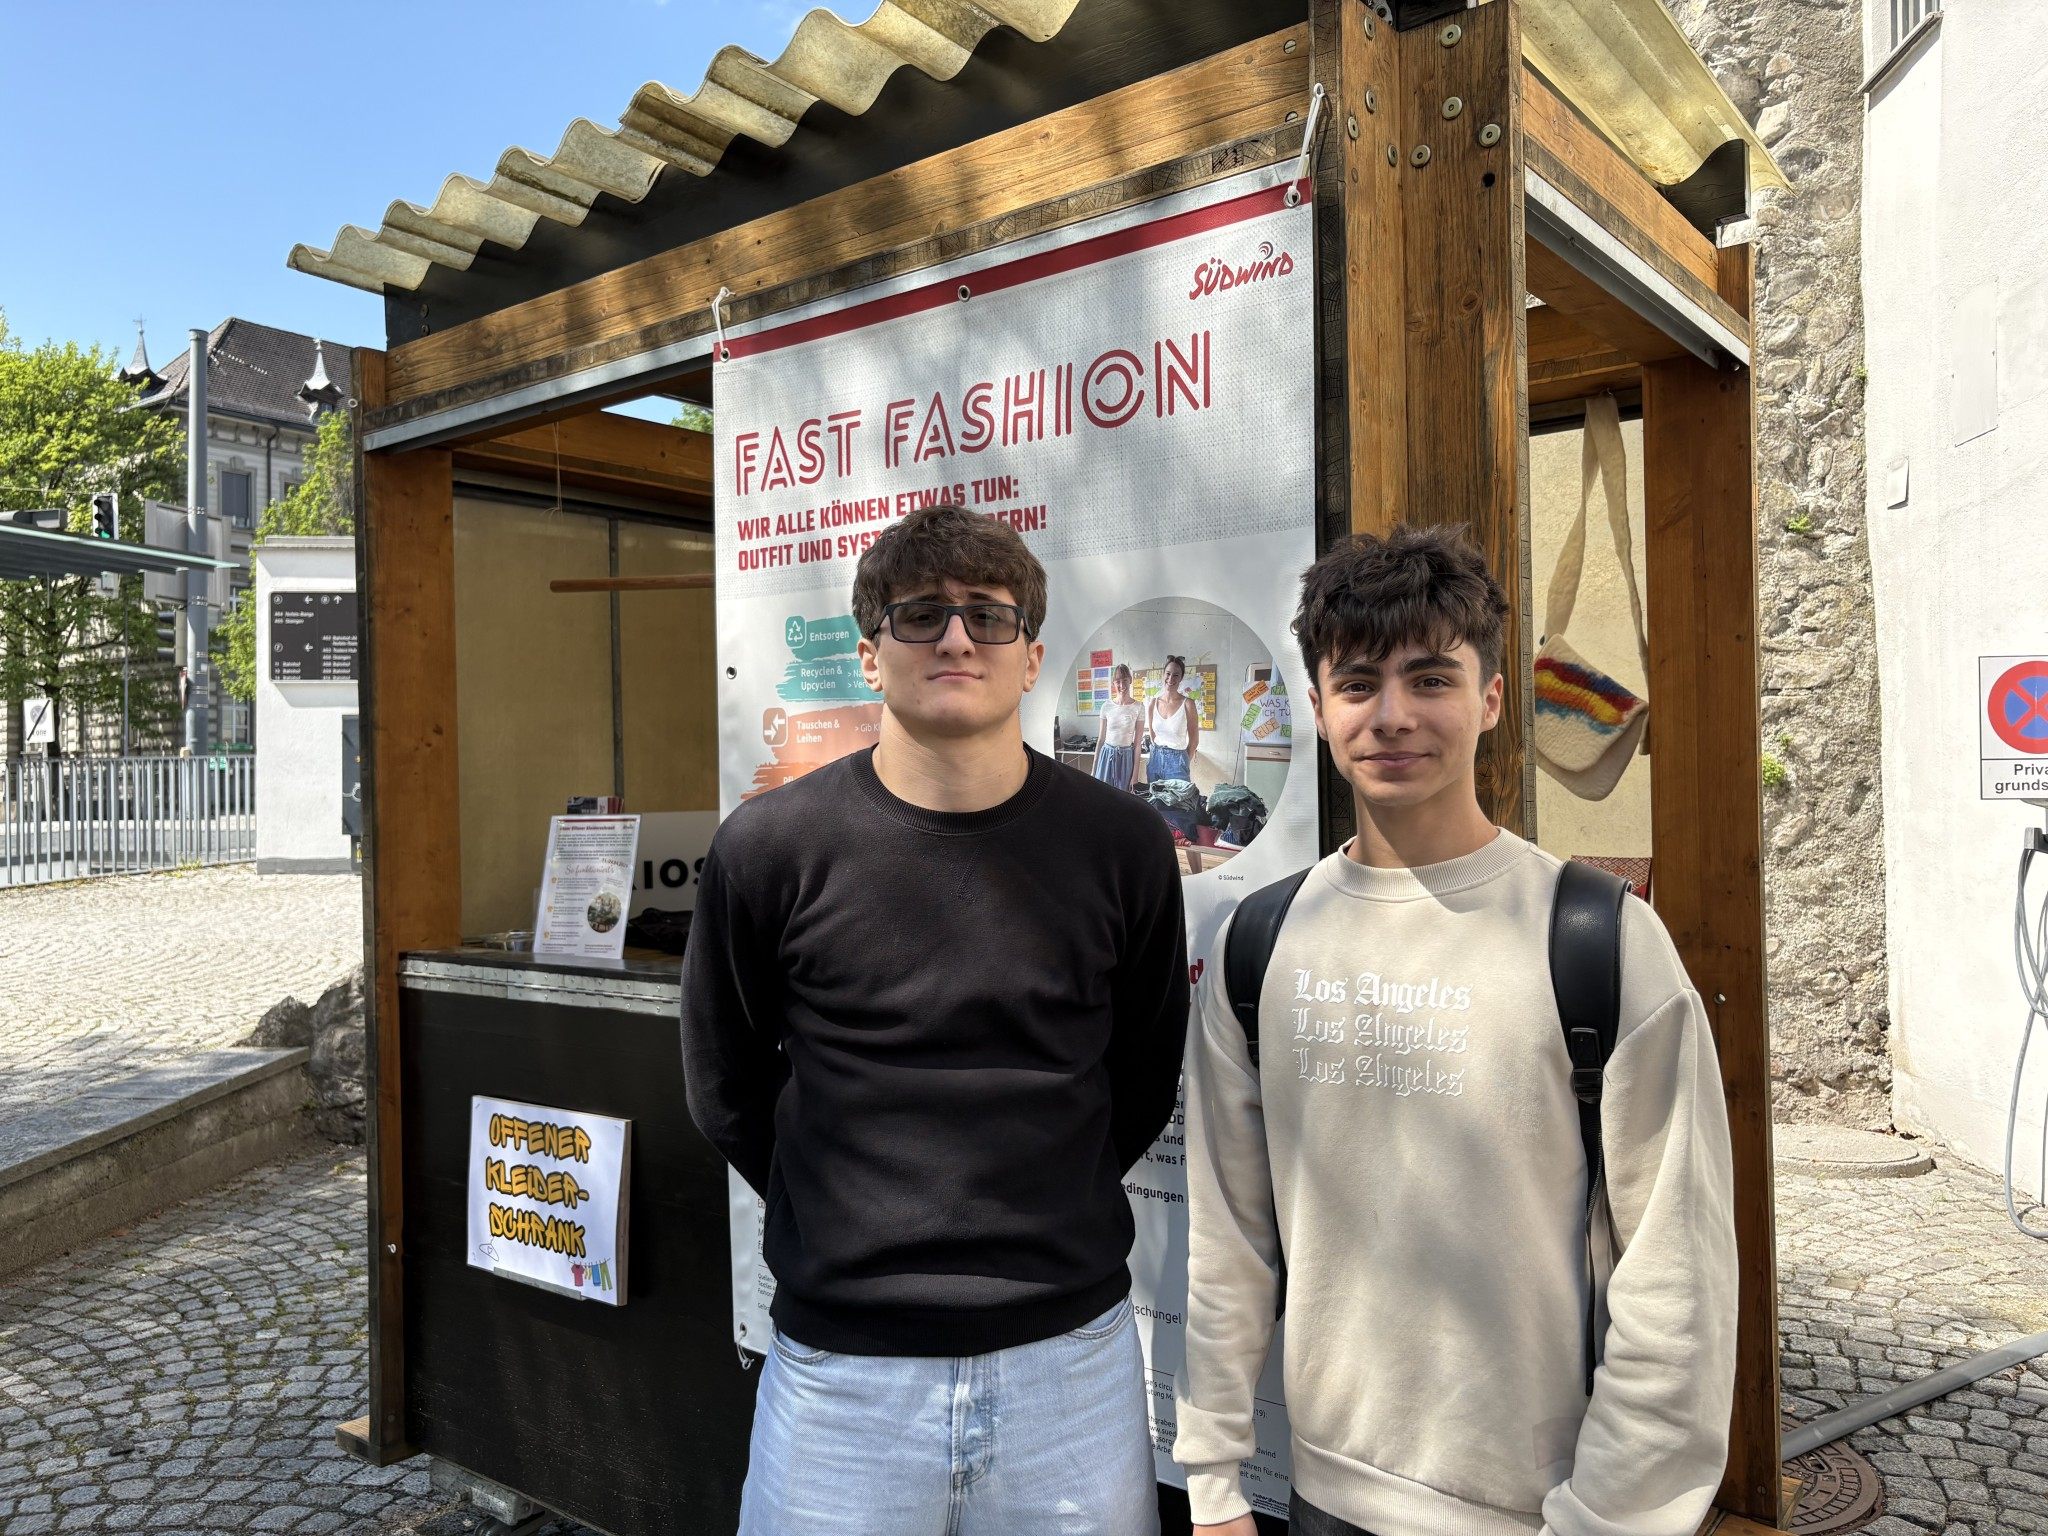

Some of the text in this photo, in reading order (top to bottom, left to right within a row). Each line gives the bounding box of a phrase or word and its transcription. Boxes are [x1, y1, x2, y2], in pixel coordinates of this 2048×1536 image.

[1189, 251, 1293, 300] SÜDWIND
[735, 330, 1211, 496] FAST FASHION
[738, 475, 1019, 541] WIR ALLE KÖNNEN ETWAS TUN:
[738, 543, 794, 571] OUTFIT
[799, 537, 832, 564] UND
[810, 629, 849, 642] Entsorgen
[801, 666, 843, 678] Recyclen &
[801, 681, 836, 691] Upcyclen
[1260, 699, 1280, 708] WAS
[797, 719, 840, 729] Tauschen &
[860, 723, 872, 732] Gib
[797, 734, 822, 743] Leihen
[1995, 778, 2048, 794] grunds
[1294, 968, 1473, 1013] Los Angeles
[1292, 1008, 1471, 1055] Los Angeles
[1293, 1048, 1465, 1096] Los Angeles
[489, 1113, 591, 1163] OFFENER
[1163, 1135, 1184, 1146] und
[1156, 1153, 1177, 1165] was
[489, 1202, 586, 1258] SCHRANK
[1135, 1304, 1182, 1325] schungel
[1263, 1467, 1274, 1476] für
[1274, 1471, 1289, 1482] eine
